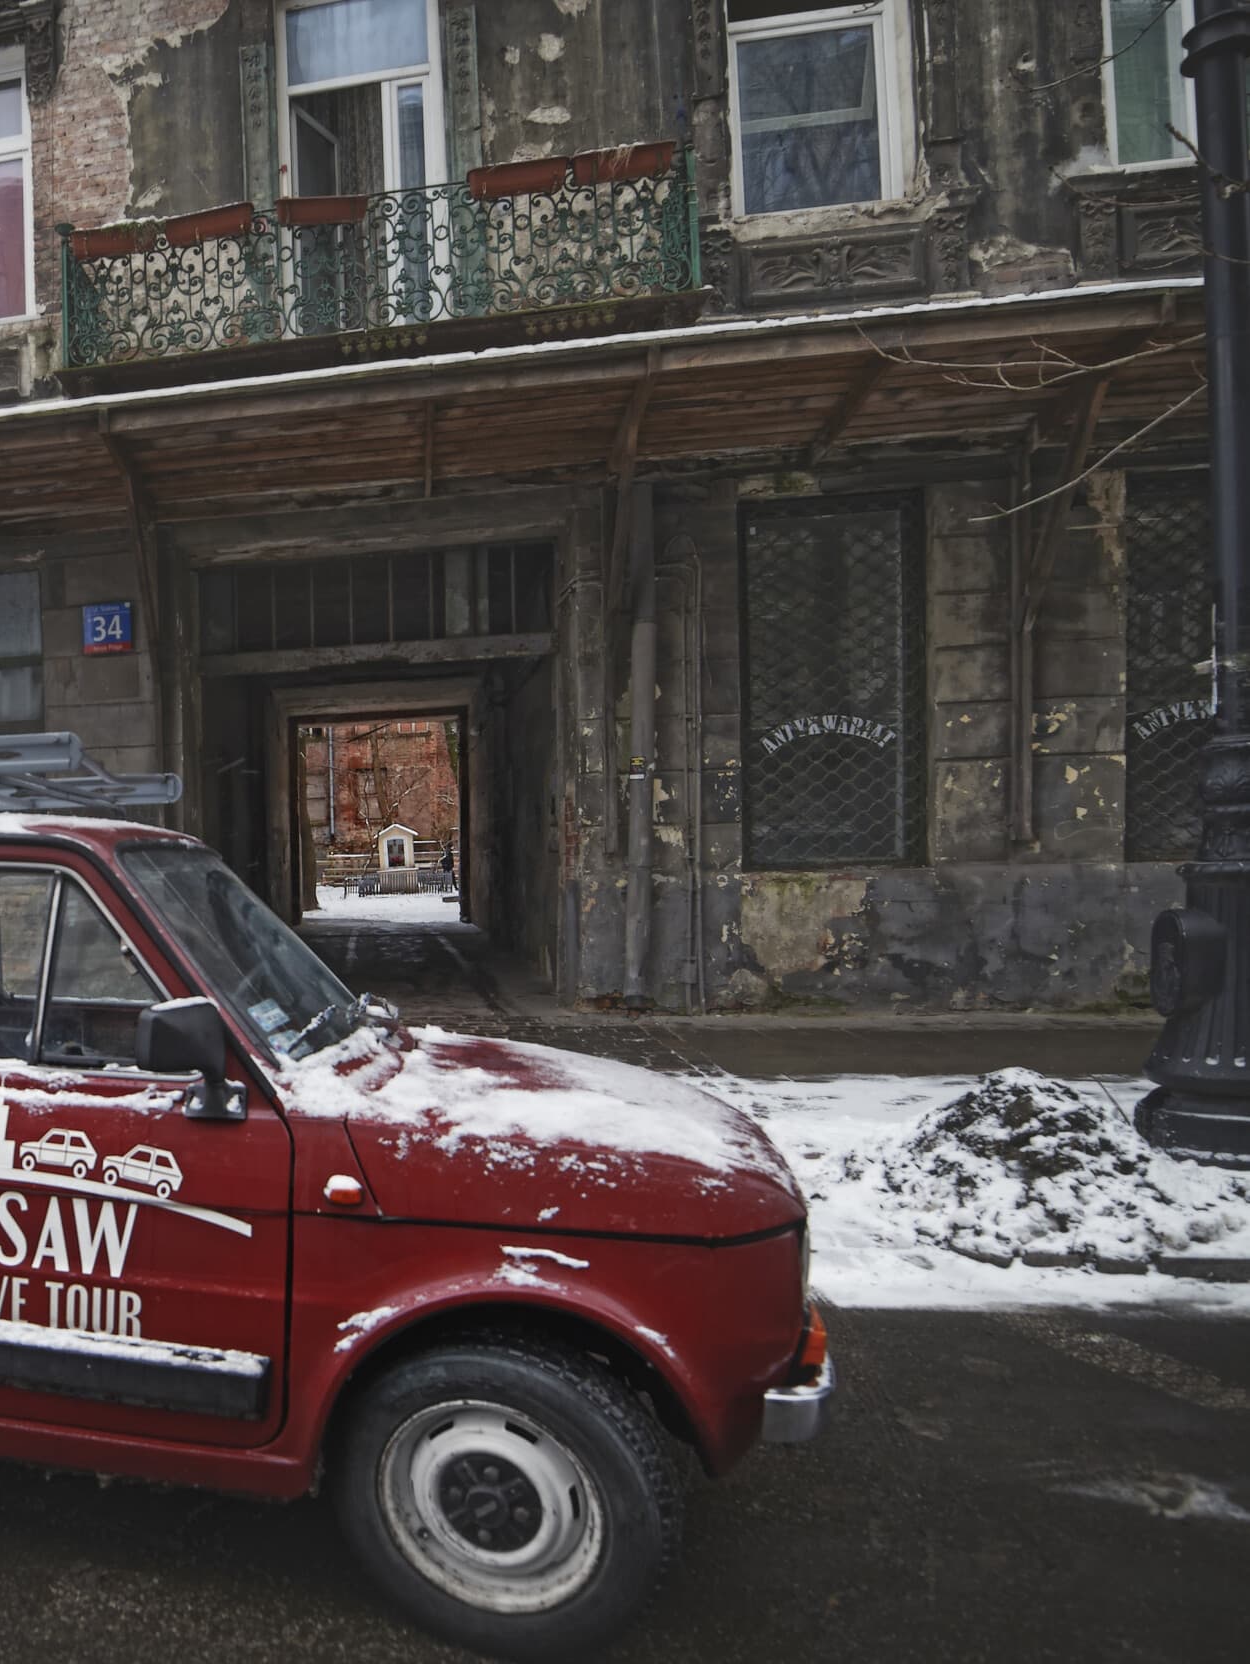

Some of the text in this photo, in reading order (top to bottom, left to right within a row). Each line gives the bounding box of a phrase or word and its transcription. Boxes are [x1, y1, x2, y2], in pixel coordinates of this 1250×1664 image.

[93, 614, 123, 642] 34
[760, 714, 897, 754] ANTYKWARIAT
[45, 1281, 142, 1338] TOUR
